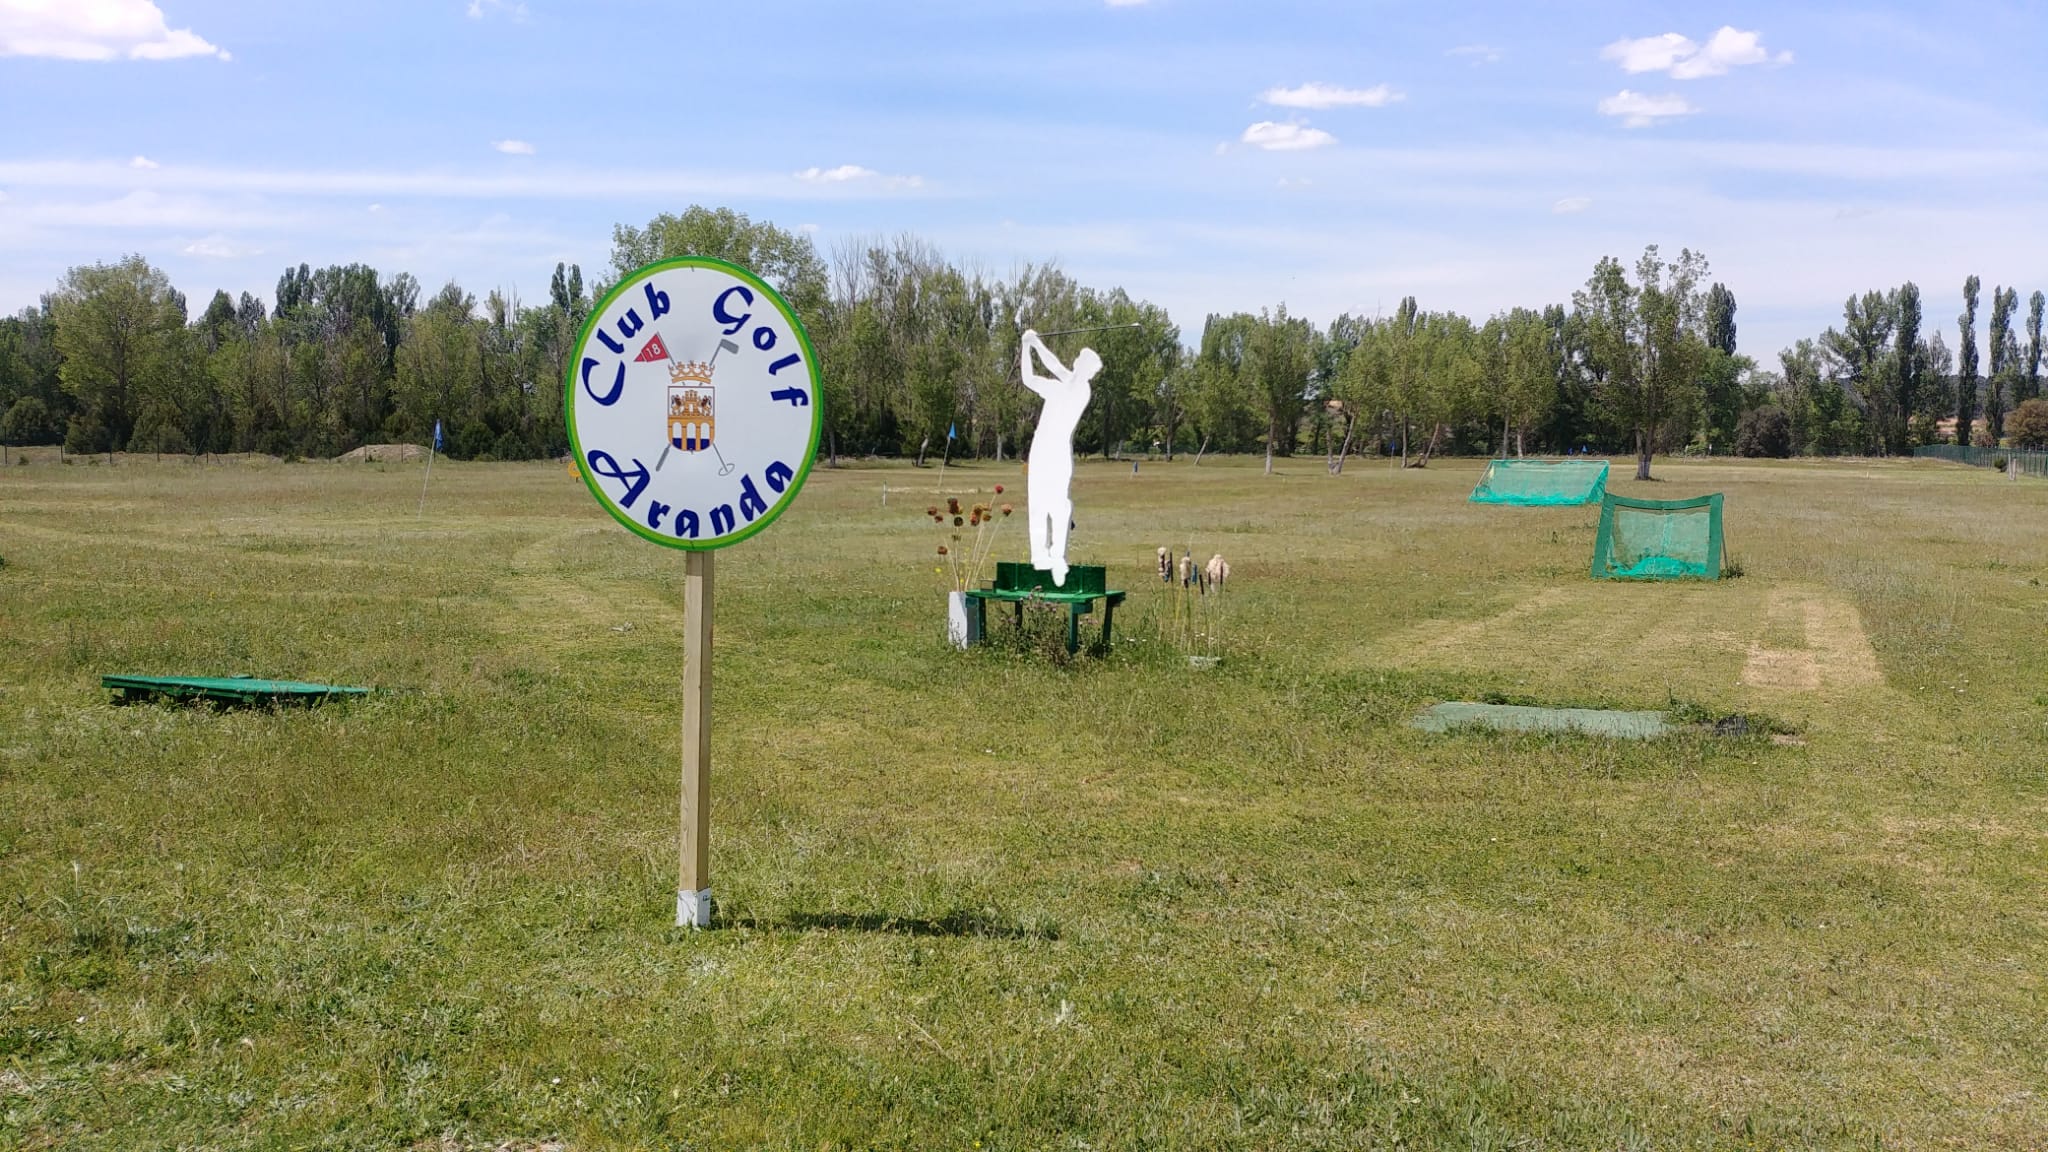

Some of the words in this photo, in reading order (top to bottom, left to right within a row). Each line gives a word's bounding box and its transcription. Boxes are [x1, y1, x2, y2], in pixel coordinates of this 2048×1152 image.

[582, 282, 671, 406] Club
[713, 286, 808, 406] Golf
[646, 343, 661, 359] 18
[587, 450, 793, 538] Aranda
